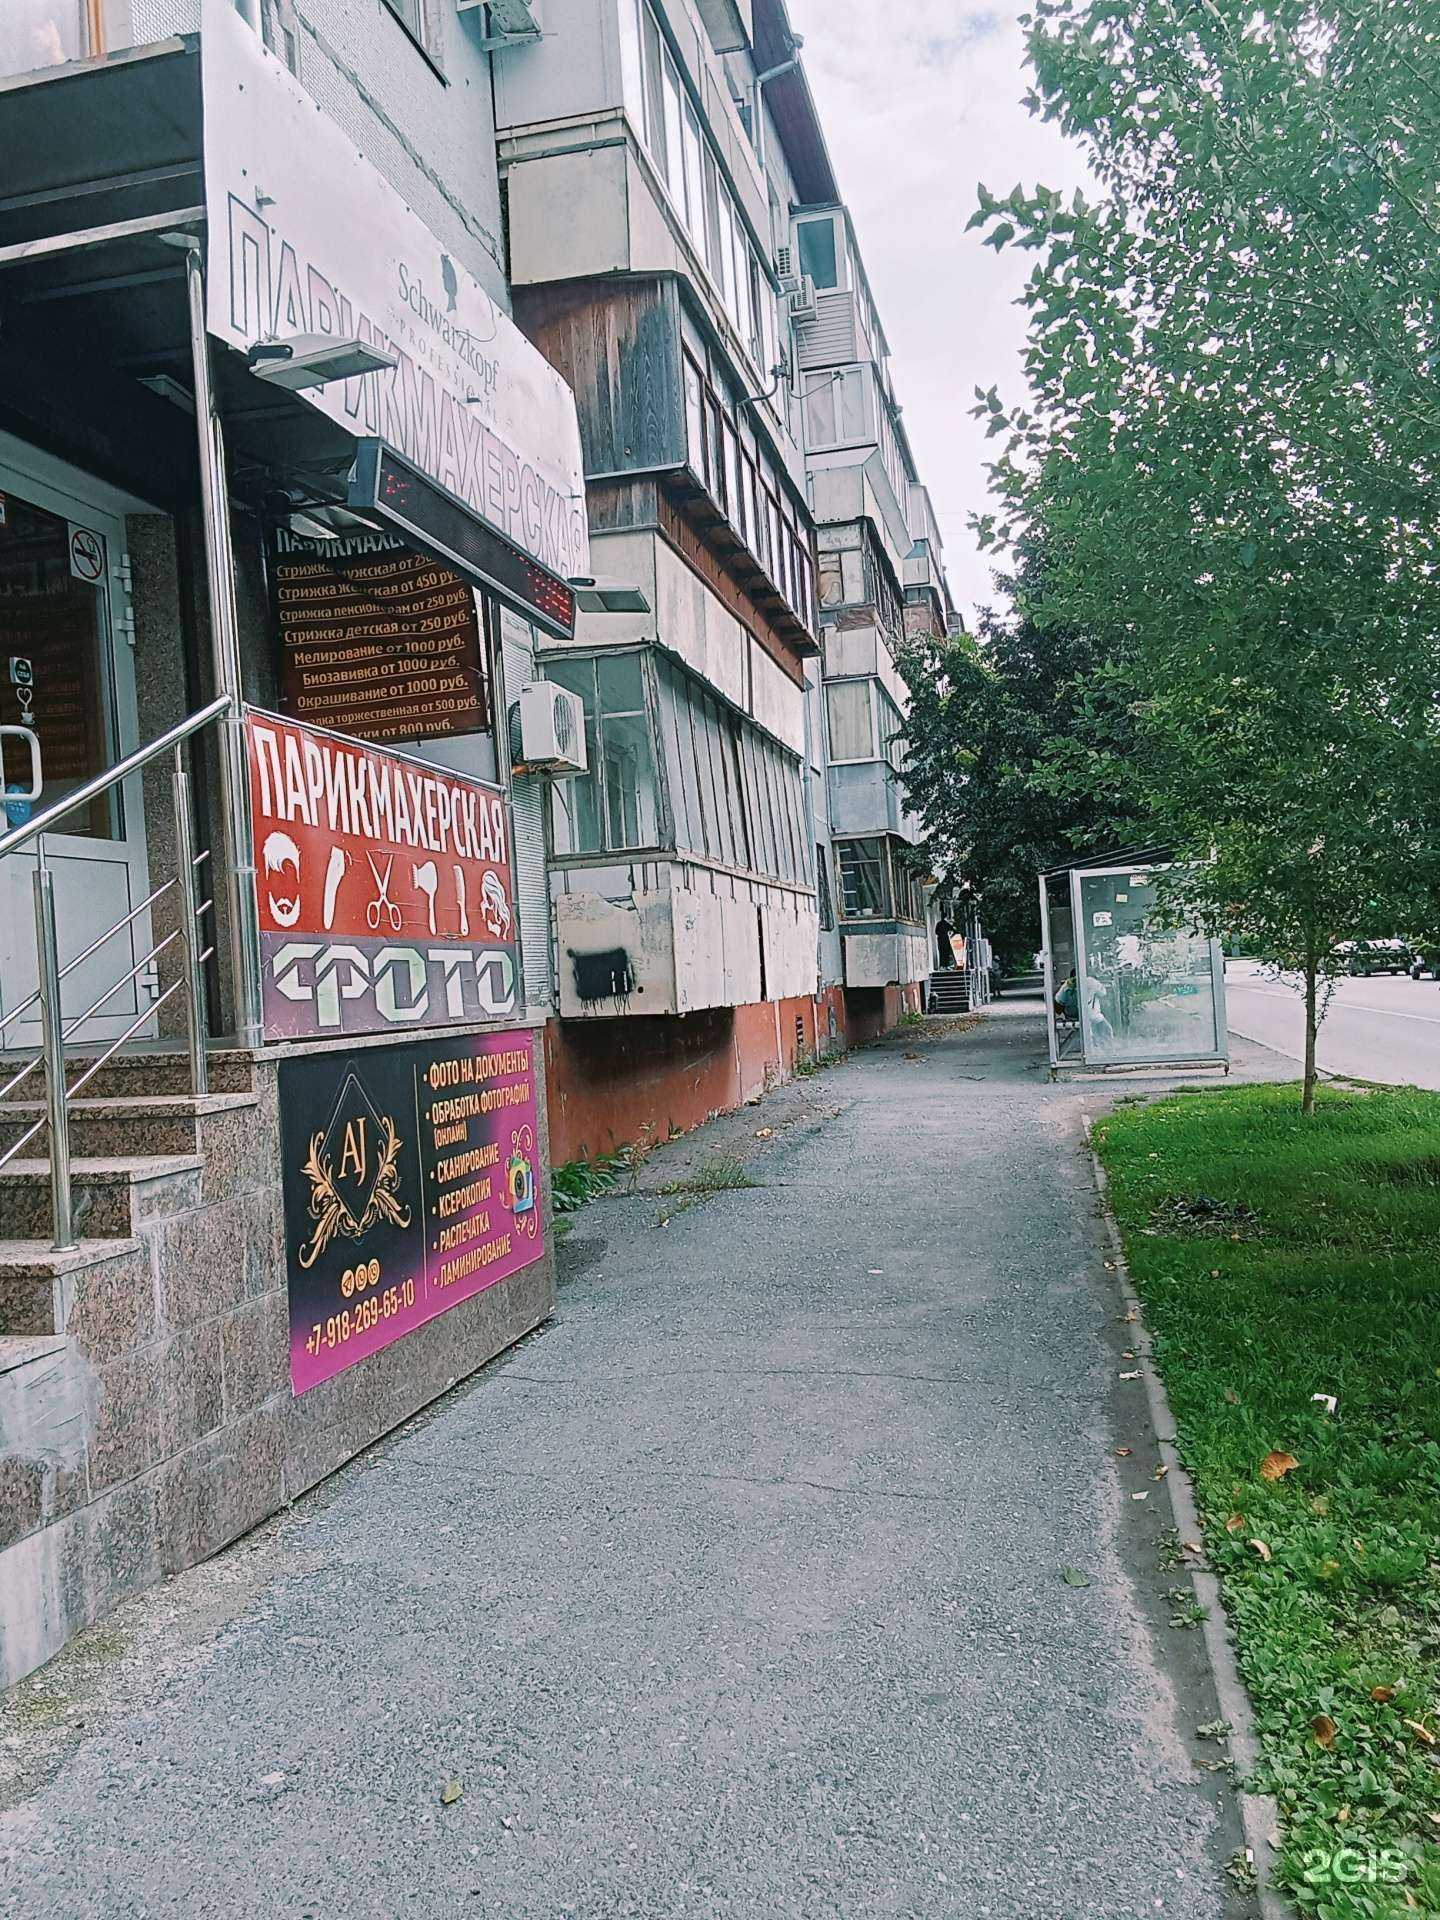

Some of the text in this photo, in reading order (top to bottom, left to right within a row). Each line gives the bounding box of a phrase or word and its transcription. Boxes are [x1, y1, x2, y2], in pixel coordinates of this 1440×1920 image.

[398, 262, 500, 396] Schwarzkopf
[278, 584, 336, 601] Стрижка
[401, 579, 413, 593] от
[416, 572, 438, 589] 450
[440, 569, 458, 586] ру
[343, 562, 396, 580] ужская
[399, 558, 413, 571] от
[279, 609, 332, 623] Стрижка
[413, 601, 425, 612] от
[427, 595, 445, 609] 250
[446, 587, 469, 607] руб.
[284, 609, 470, 645] Стрижка детская от 250 руб.
[294, 634, 465, 665] Мелирование от 1000 руб.
[303, 656, 461, 686] Биозавивка от 1000 руб.
[297, 674, 469, 709] Окрашивание от 1000 руб.
[336, 705, 420, 724] торжественная
[421, 703, 433, 713] от
[435, 699, 455, 710] 500
[457, 695, 481, 711] руб.
[252, 724, 508, 866] ПАРИКМАХЕРСКАЯ
[272, 943, 516, 1027] ФОТО
[430, 1049, 529, 1089] ФОТО НА ДОКУМЕНТЫ
[431, 1077, 531, 1126] ОБРАБОТКА ФОТОГРАФИЙ
[434, 1119, 467, 1151] (ОНЛАЙН)
[437, 1142, 500, 1182] СКАНИРОВАНИЕ
[439, 1177, 492, 1220] КСЕРОКОПИЯ
[439, 1211, 491, 1252] РАСПЕЧАТКА
[440, 1233, 512, 1289] ЛАМИНИРОВАНИЕ
[305, 1278, 416, 1358] +7-918-269-65-10
